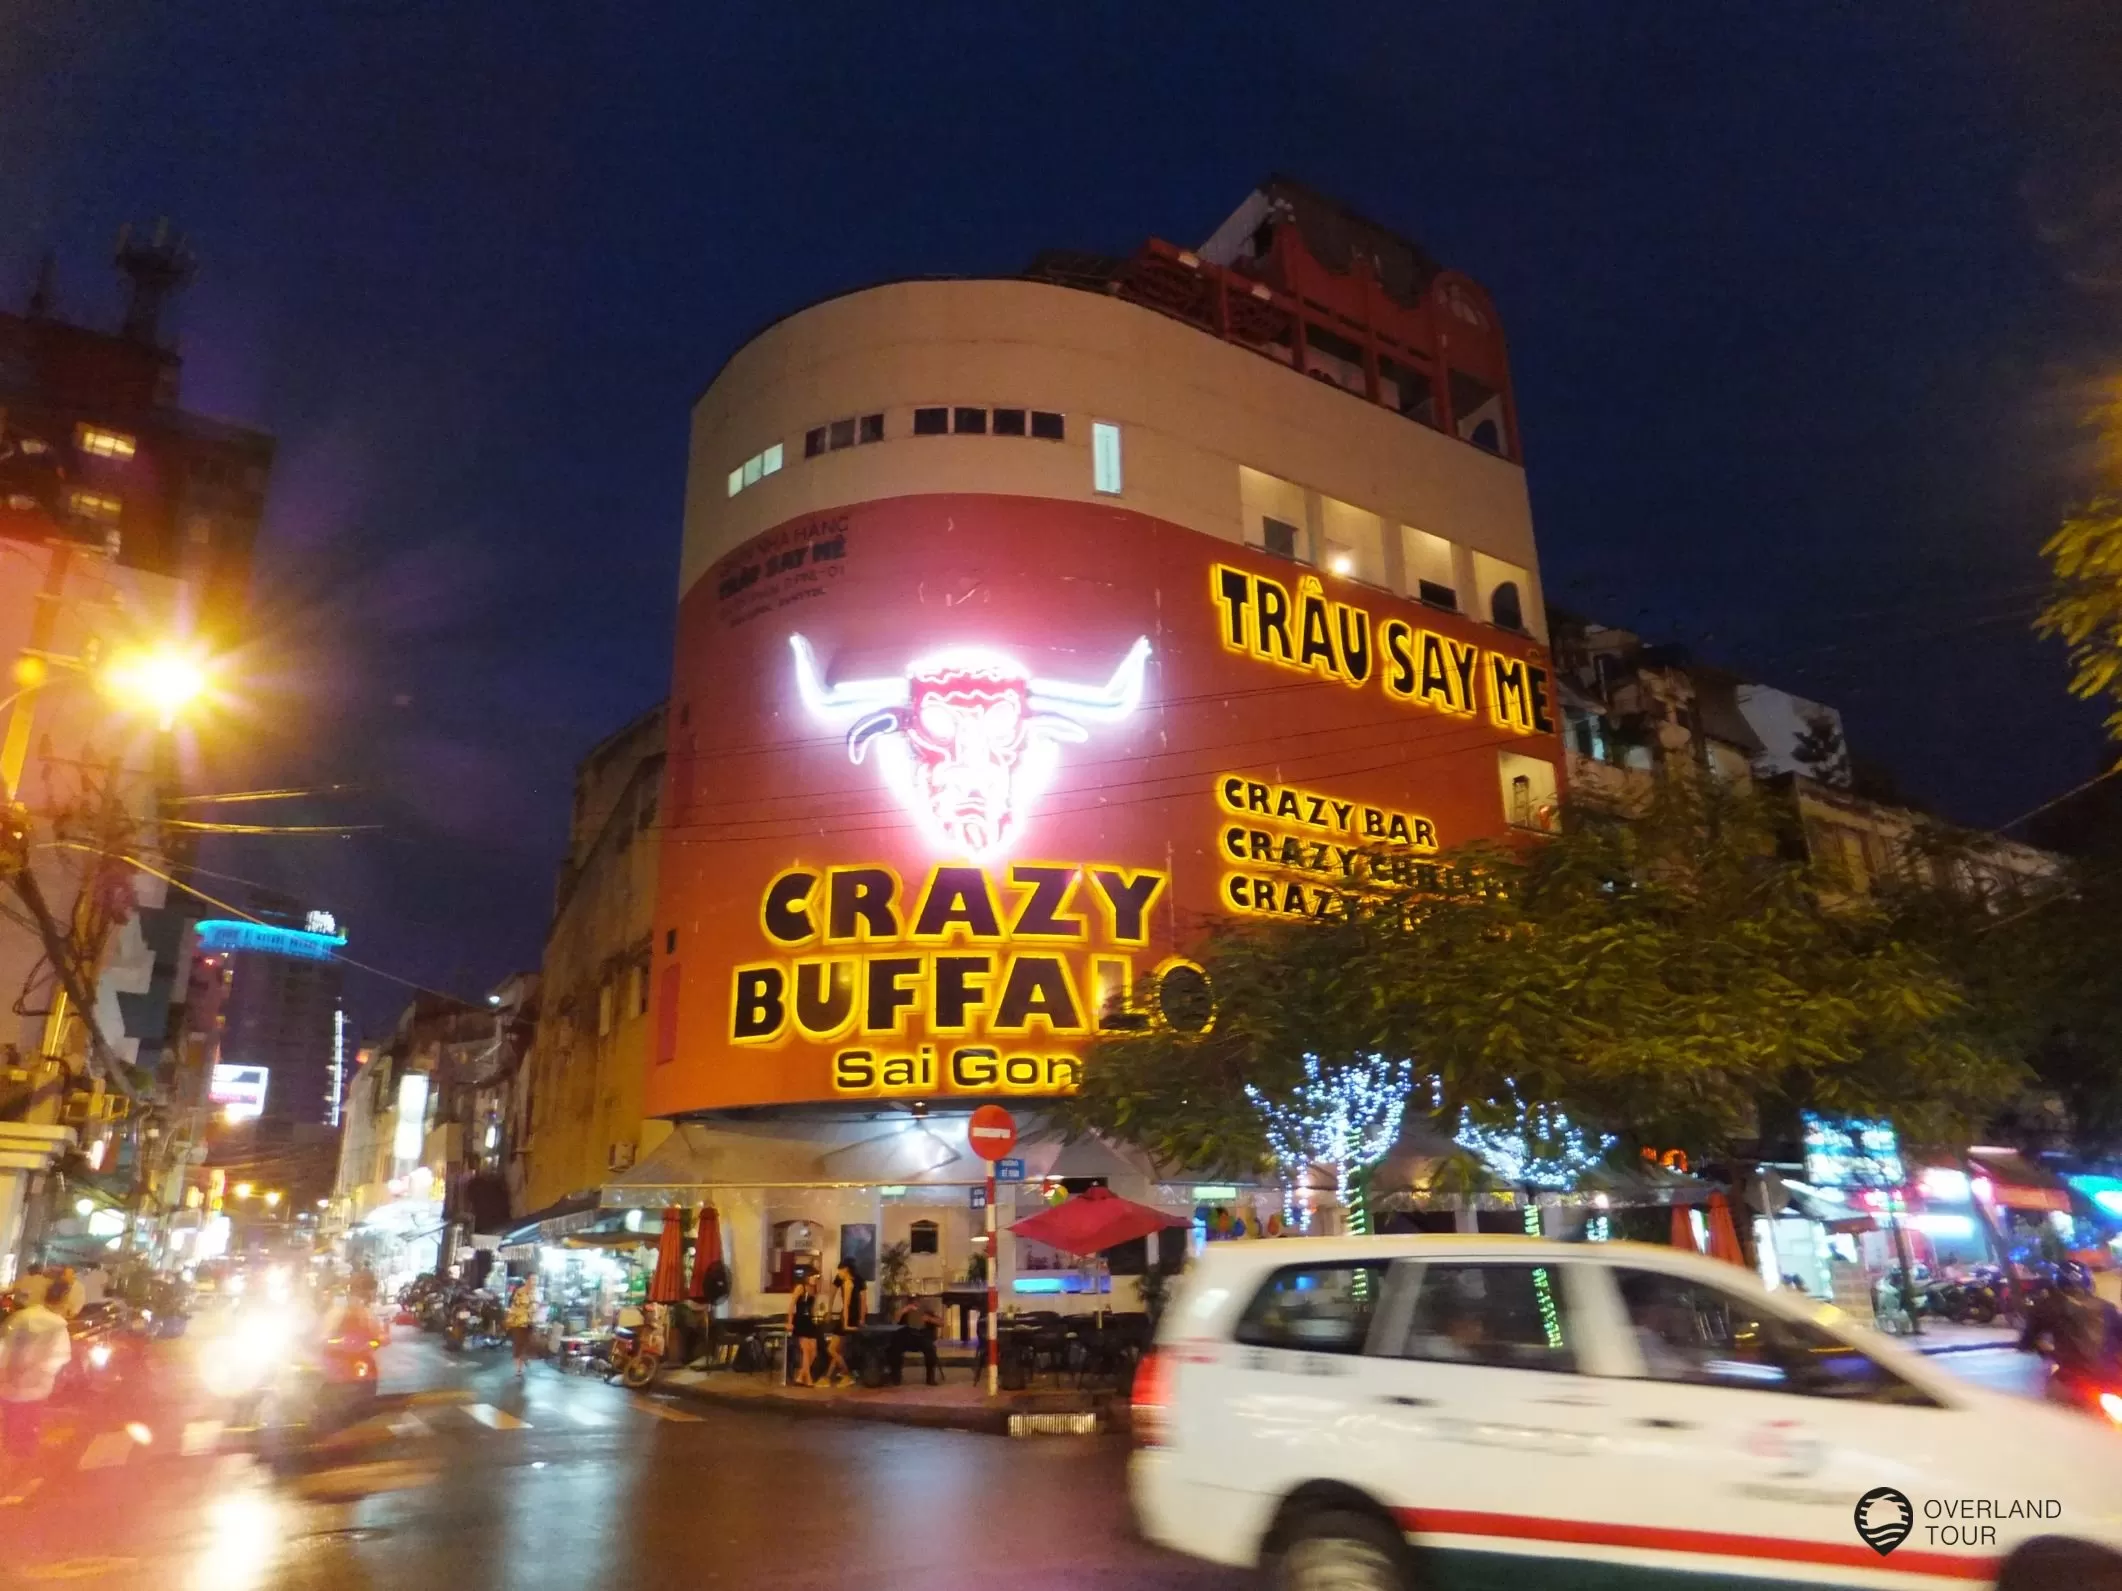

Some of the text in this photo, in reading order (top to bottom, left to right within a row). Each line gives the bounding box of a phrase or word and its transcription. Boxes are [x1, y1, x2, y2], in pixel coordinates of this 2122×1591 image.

[1212, 563, 1372, 684] TRÂU
[1380, 619, 1479, 719] SAY
[1221, 776, 1438, 850] CRAZY BAR
[1224, 825, 1358, 878] CRAZY
[762, 863, 1169, 946] CRAZY
[1227, 873, 1344, 921] CRAZ
[729, 950, 1217, 1044] BUFFALO
[833, 1045, 1083, 1091] Sai Gon
